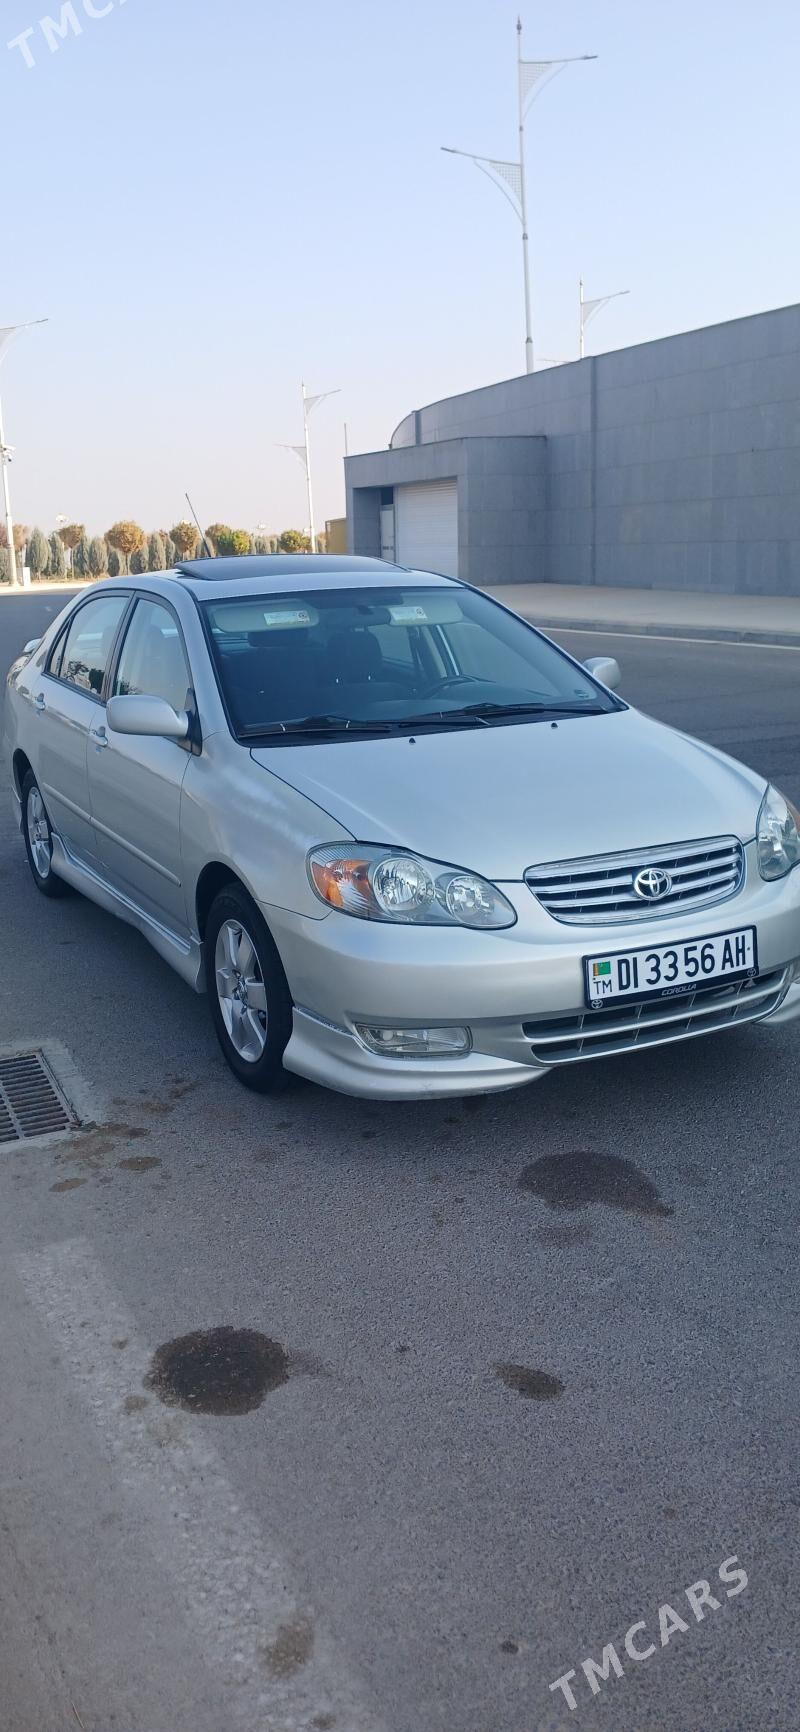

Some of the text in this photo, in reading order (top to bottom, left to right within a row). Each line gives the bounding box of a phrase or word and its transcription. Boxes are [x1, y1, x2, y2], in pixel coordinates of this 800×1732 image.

[617, 957, 639, 991] DI
[721, 935, 746, 970] AH
[593, 979, 613, 994] TM
[661, 983, 697, 996] COROLLA
